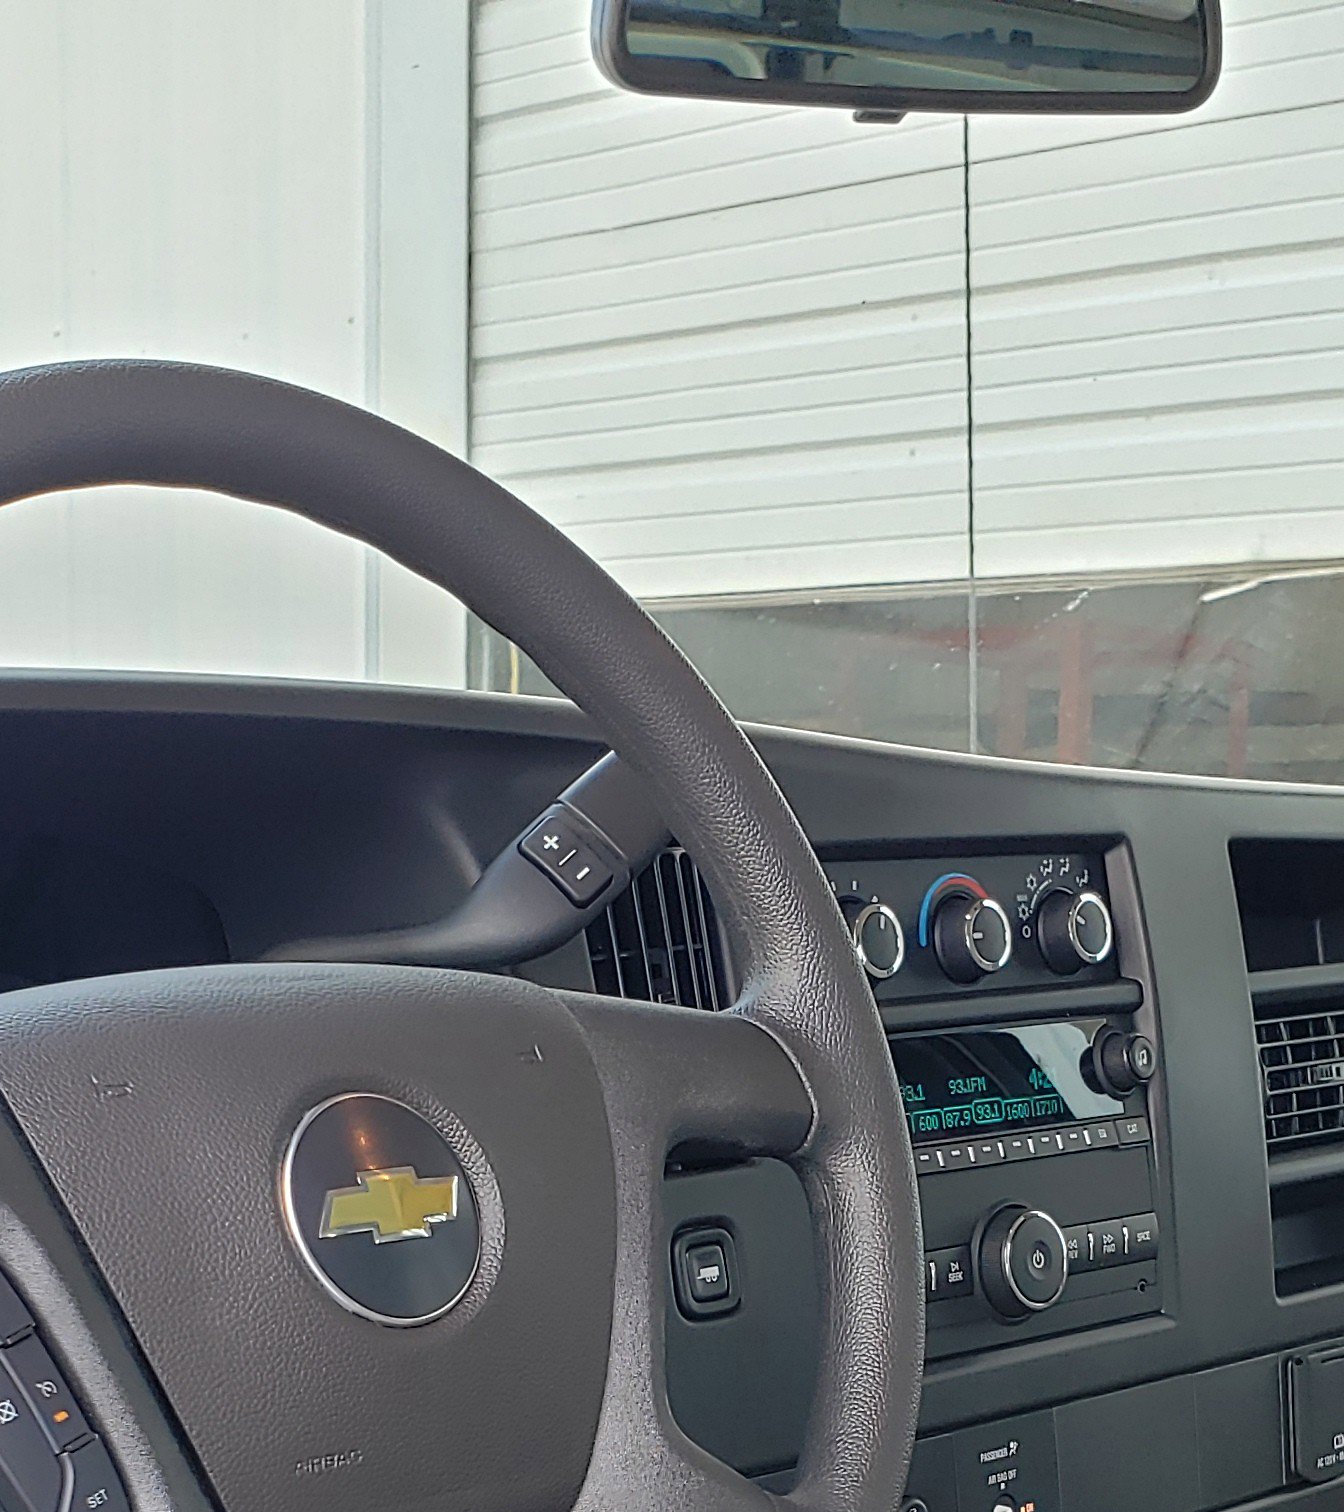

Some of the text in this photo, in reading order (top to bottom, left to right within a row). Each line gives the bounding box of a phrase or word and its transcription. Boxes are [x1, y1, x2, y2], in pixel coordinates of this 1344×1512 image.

[918, 1099, 1058, 1132] 600 87.9 93.1 1600 1710
[948, 1271, 964, 1283] SEEK
[87, 1488, 109, 1510] SET
